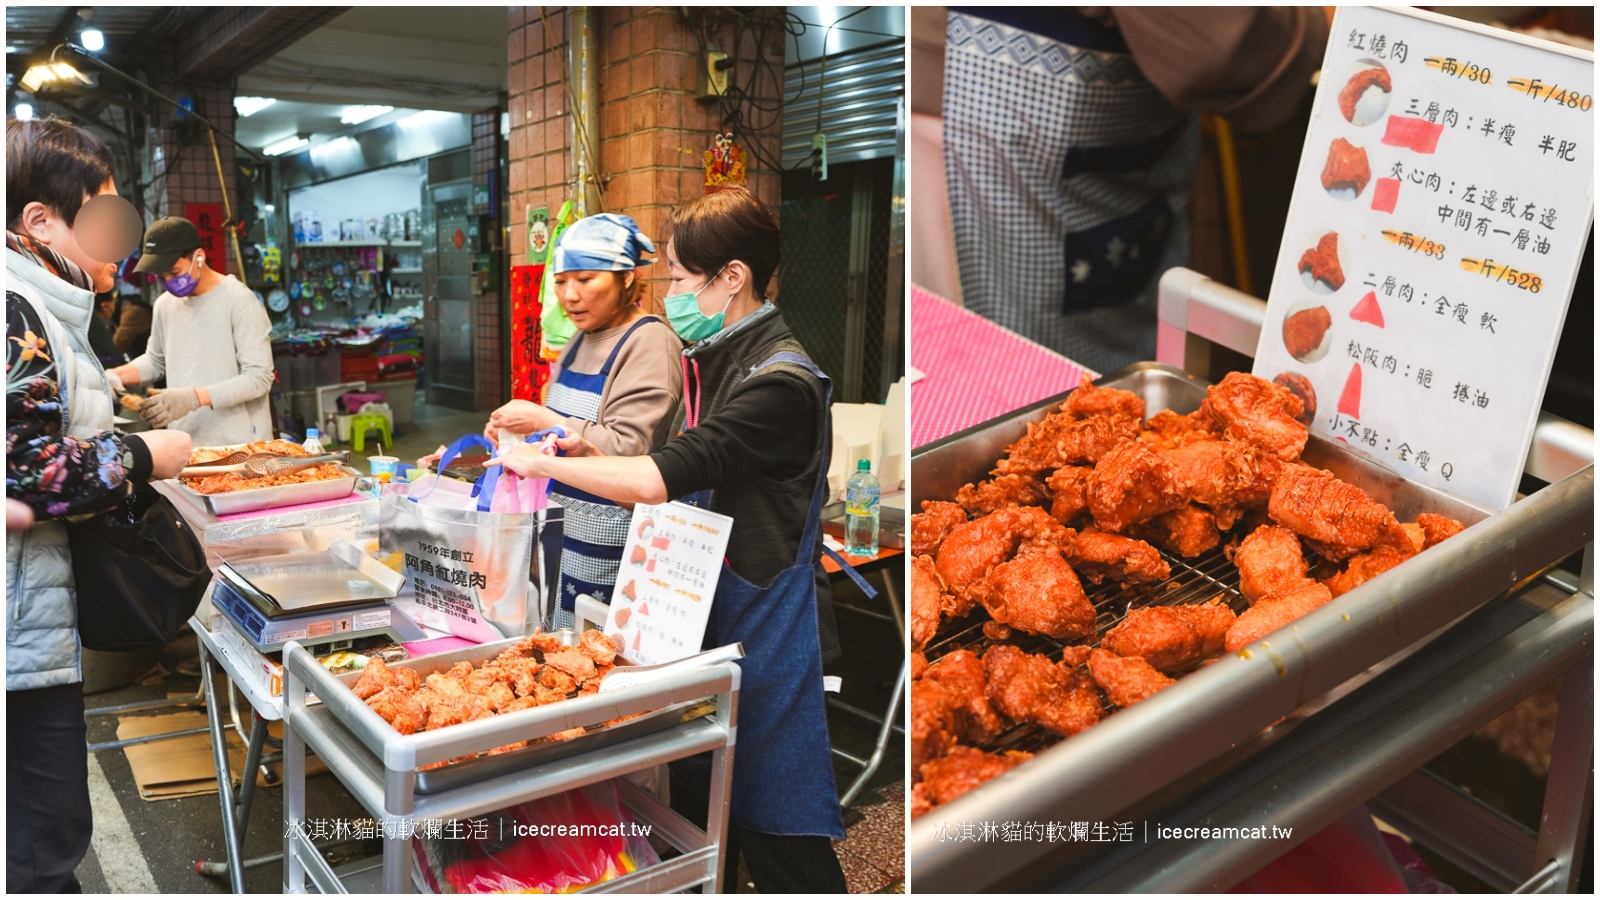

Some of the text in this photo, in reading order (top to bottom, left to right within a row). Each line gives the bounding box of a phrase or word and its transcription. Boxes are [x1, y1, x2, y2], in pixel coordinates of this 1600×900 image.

[1348, 29, 1593, 112] 紅燒肉 一兩/30 一斤/480
[1538, 135, 1577, 162] 半肥
[1437, 204, 1551, 256] 中間有一層油
[1381, 229, 1543, 294] 一兩/33 一斤/528
[1480, 311, 1498, 334] 軟
[1453, 381, 1490, 409] 捲油
[1440, 462, 1454, 481] Q
[418, 541, 474, 563] 1959年創立
[405, 553, 487, 590] 阿角紅燒肉
